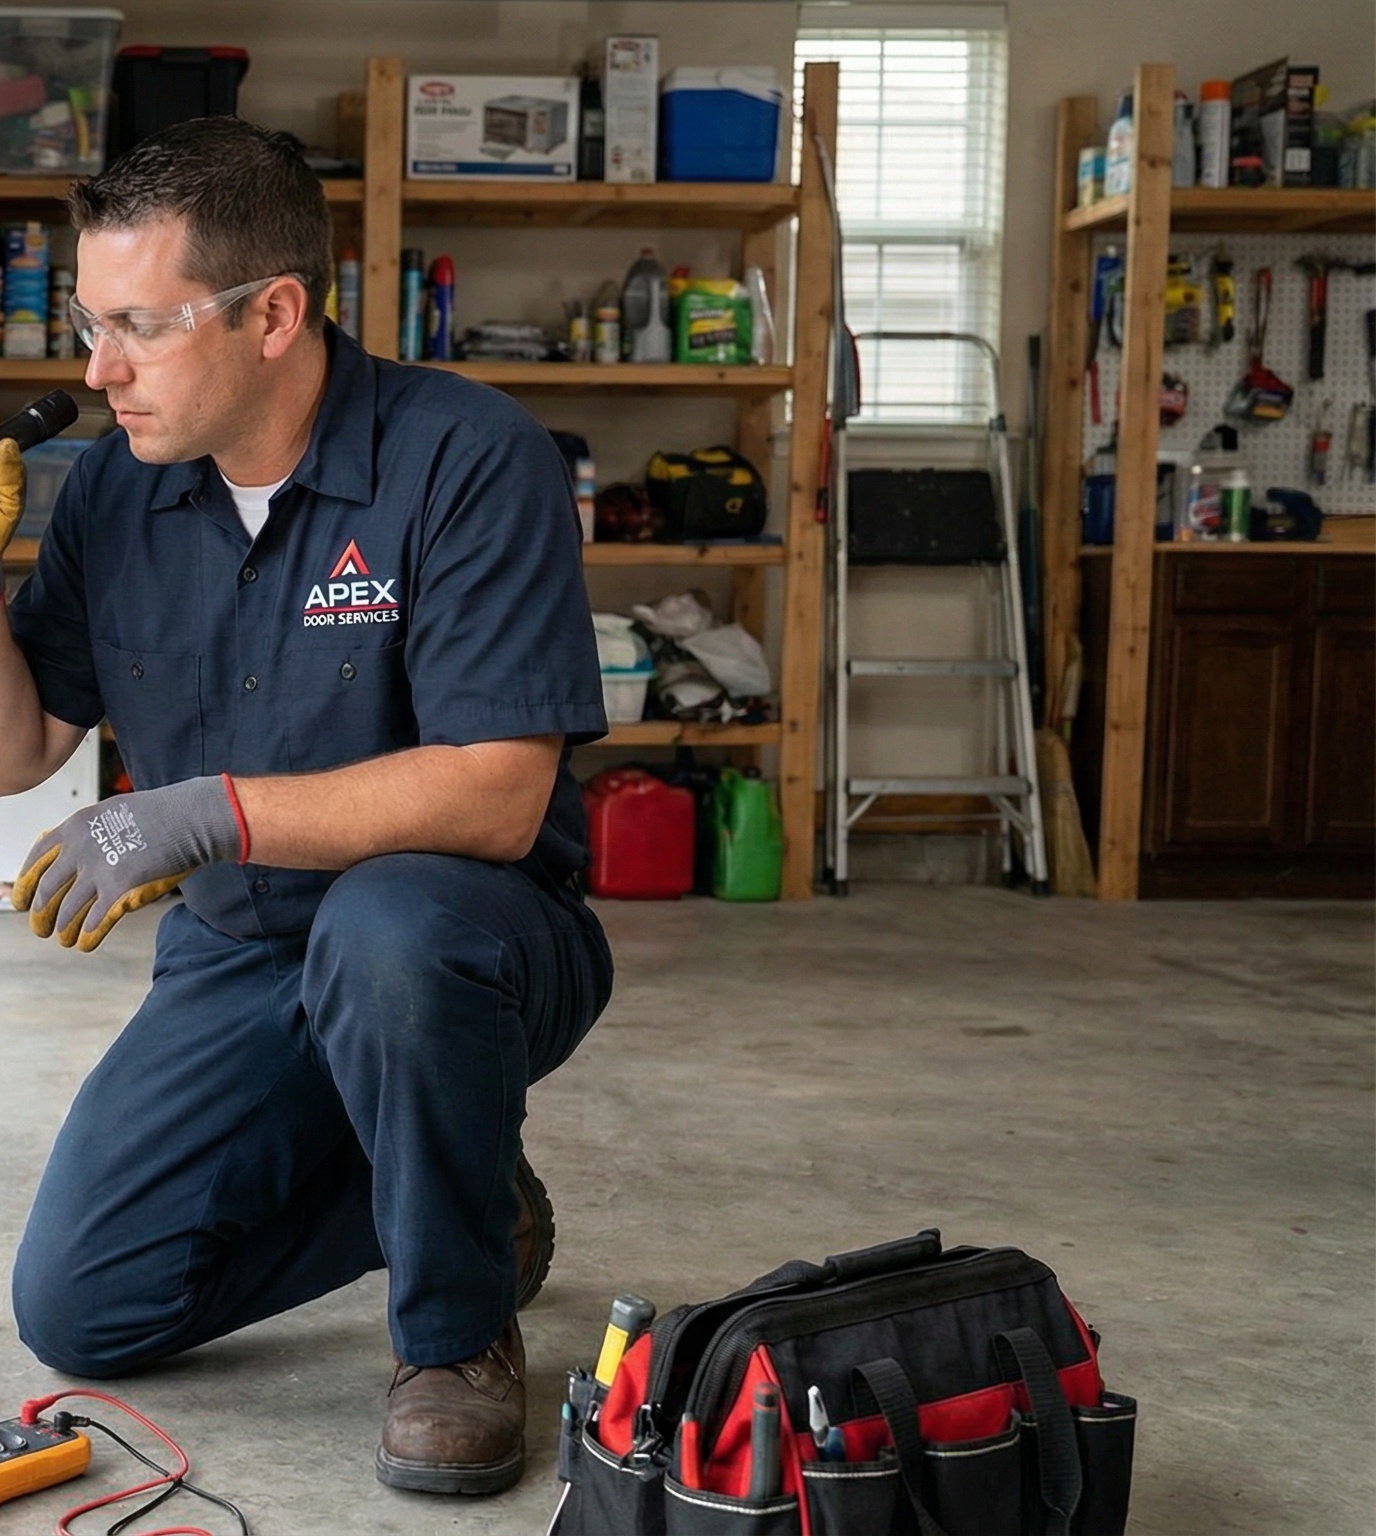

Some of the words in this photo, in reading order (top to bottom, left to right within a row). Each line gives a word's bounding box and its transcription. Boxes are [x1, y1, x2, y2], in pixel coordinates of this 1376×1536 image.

[305, 579, 398, 609] APEX
[304, 614, 335, 627] DOOR
[338, 610, 400, 625] SERVICES
